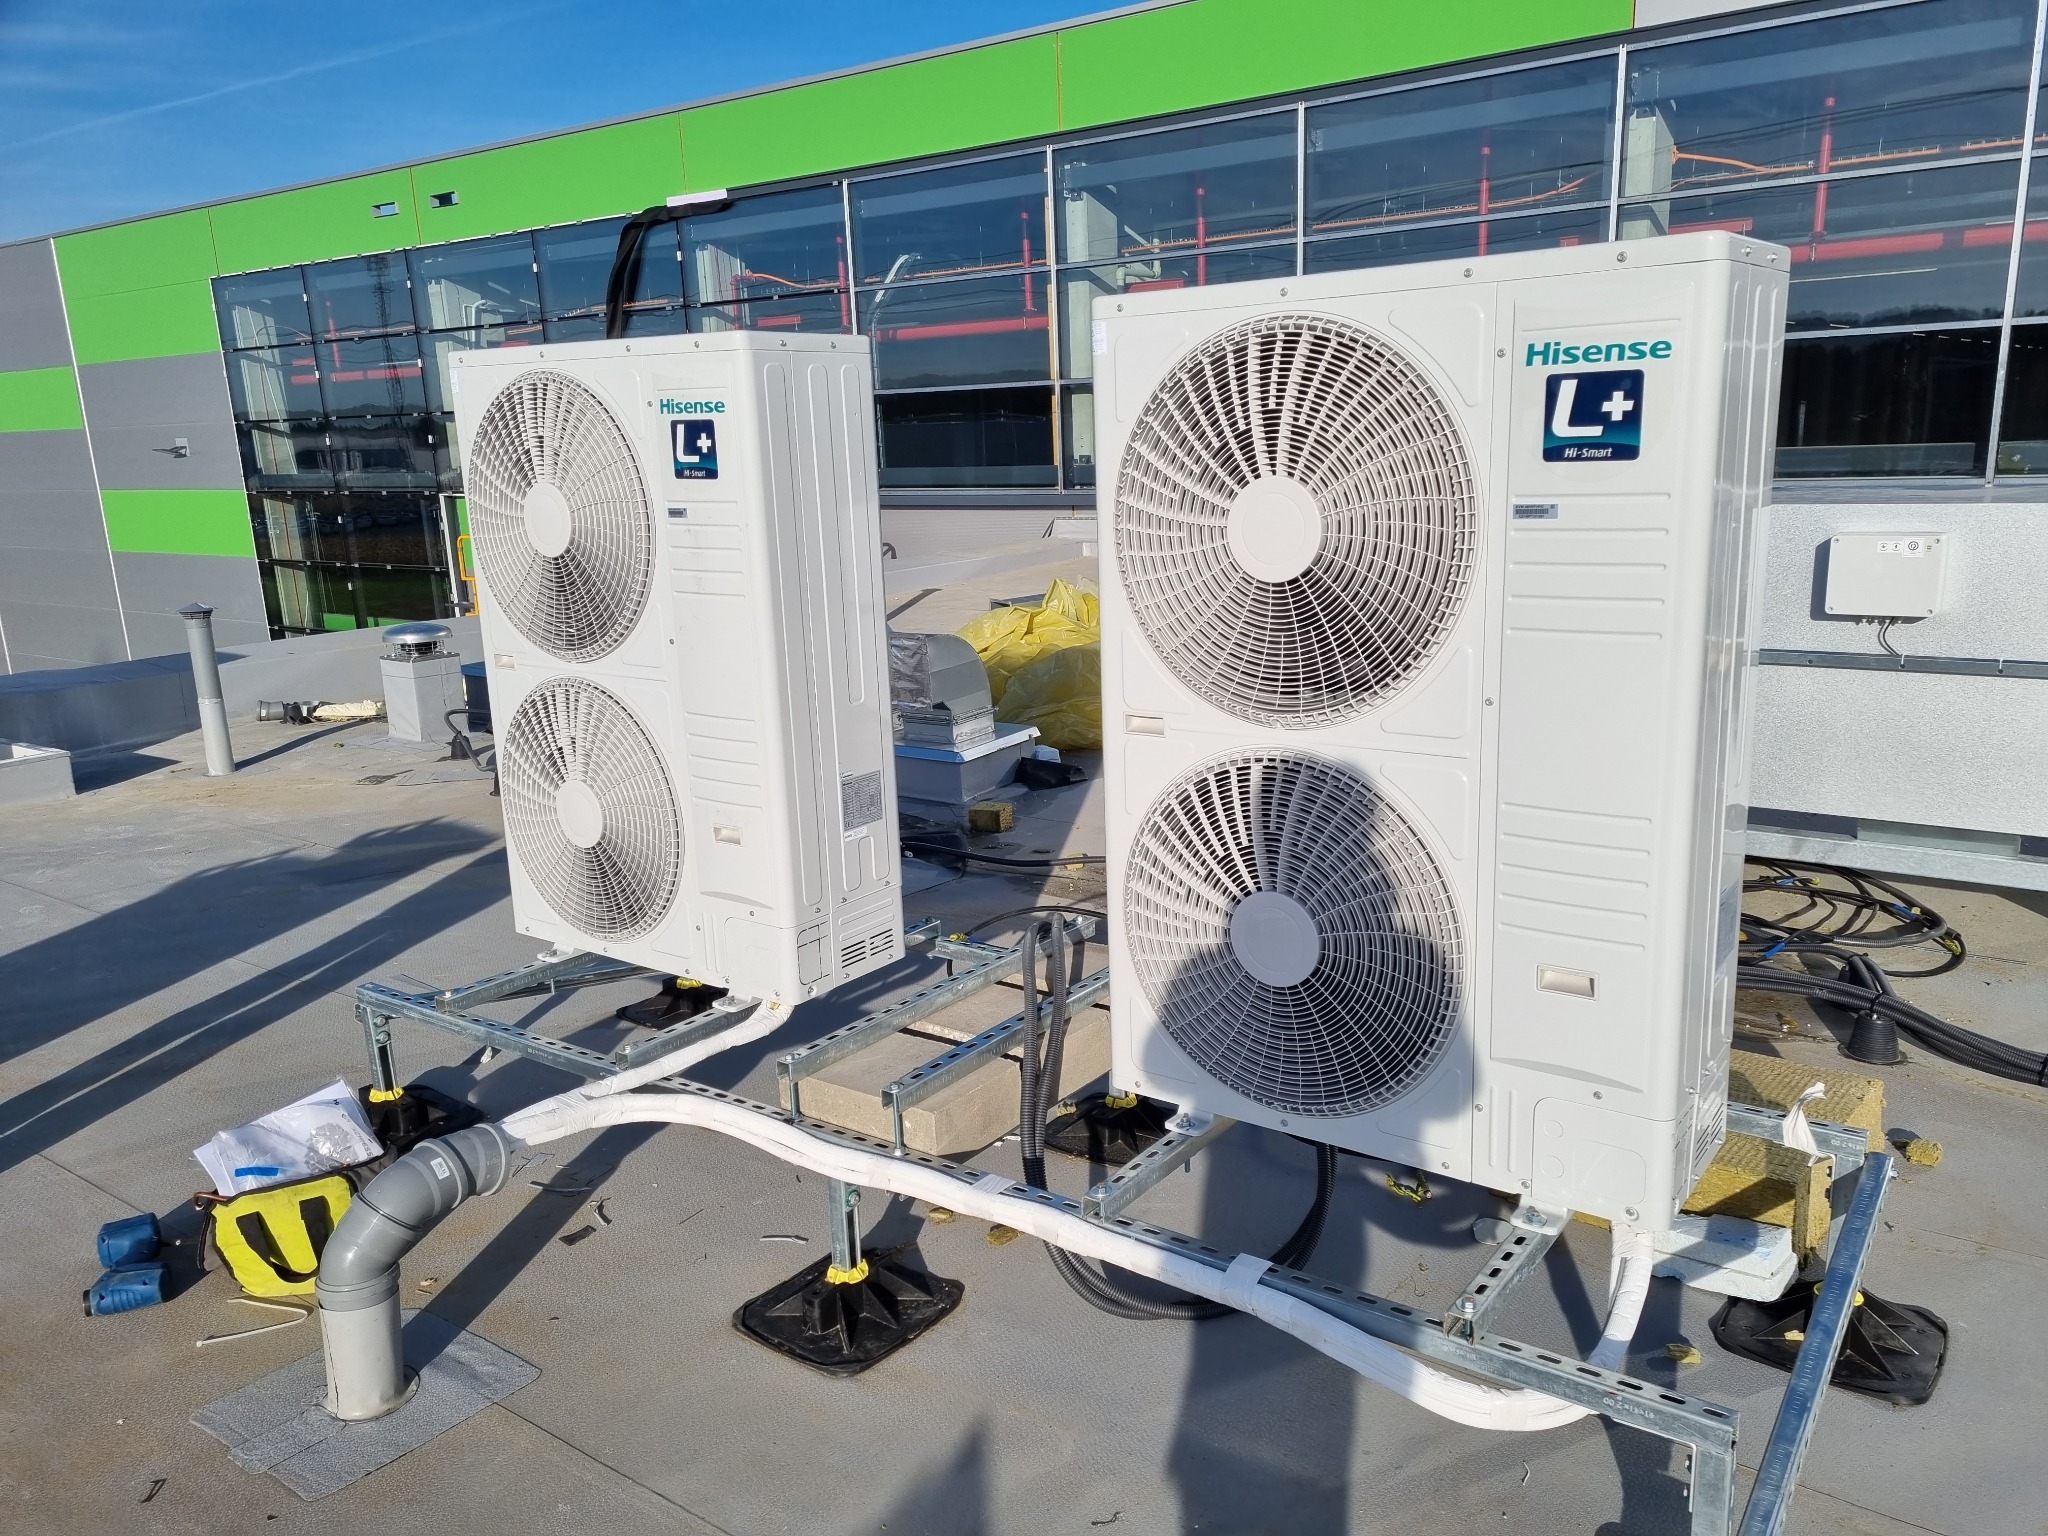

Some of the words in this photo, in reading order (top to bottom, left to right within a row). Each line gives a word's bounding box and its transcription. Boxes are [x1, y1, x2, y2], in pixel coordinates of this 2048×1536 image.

[1526, 340, 1672, 367] Hisense
[660, 399, 725, 415] Hisense
[1552, 379, 1635, 438] L+
[676, 424, 712, 463] L+
[1564, 446, 1613, 458] Hi-Smart
[684, 469, 706, 477] Hi-Smart
